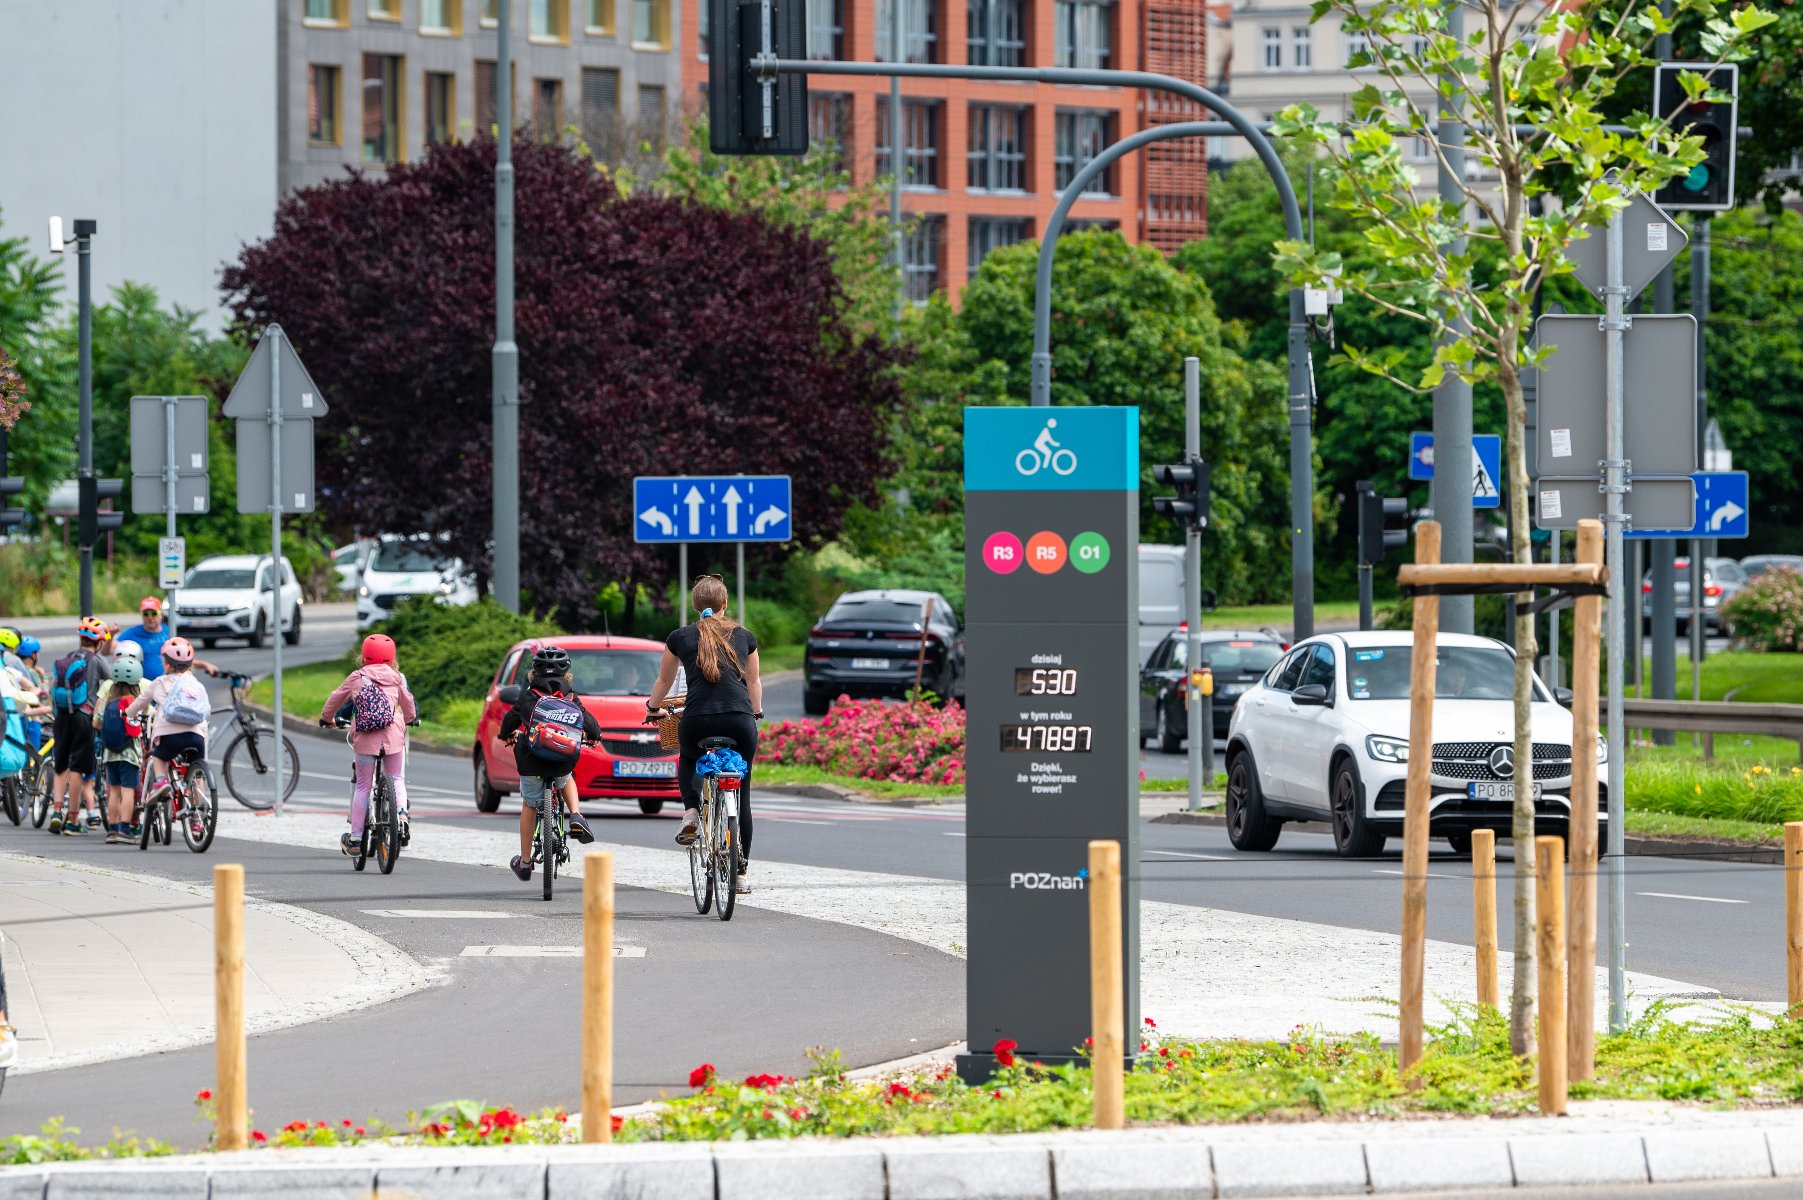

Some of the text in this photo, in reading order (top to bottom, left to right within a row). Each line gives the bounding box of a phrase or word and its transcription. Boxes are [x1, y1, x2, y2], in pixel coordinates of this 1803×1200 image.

[993, 546, 1014, 560] R3
[1036, 546, 1057, 560] R5
[1031, 654, 1062, 665] dzisiaj
[1031, 669, 1077, 695] 530
[1020, 711, 1072, 722] w tym roku
[1017, 726, 1092, 751] 47897
[621, 762, 674, 775] PO 749TR
[1031, 762, 1062, 773] Dzięki,
[1017, 773, 1077, 785] że wybierasz
[1032, 784, 1062, 793] rower!
[1478, 784, 1494, 797] PO
